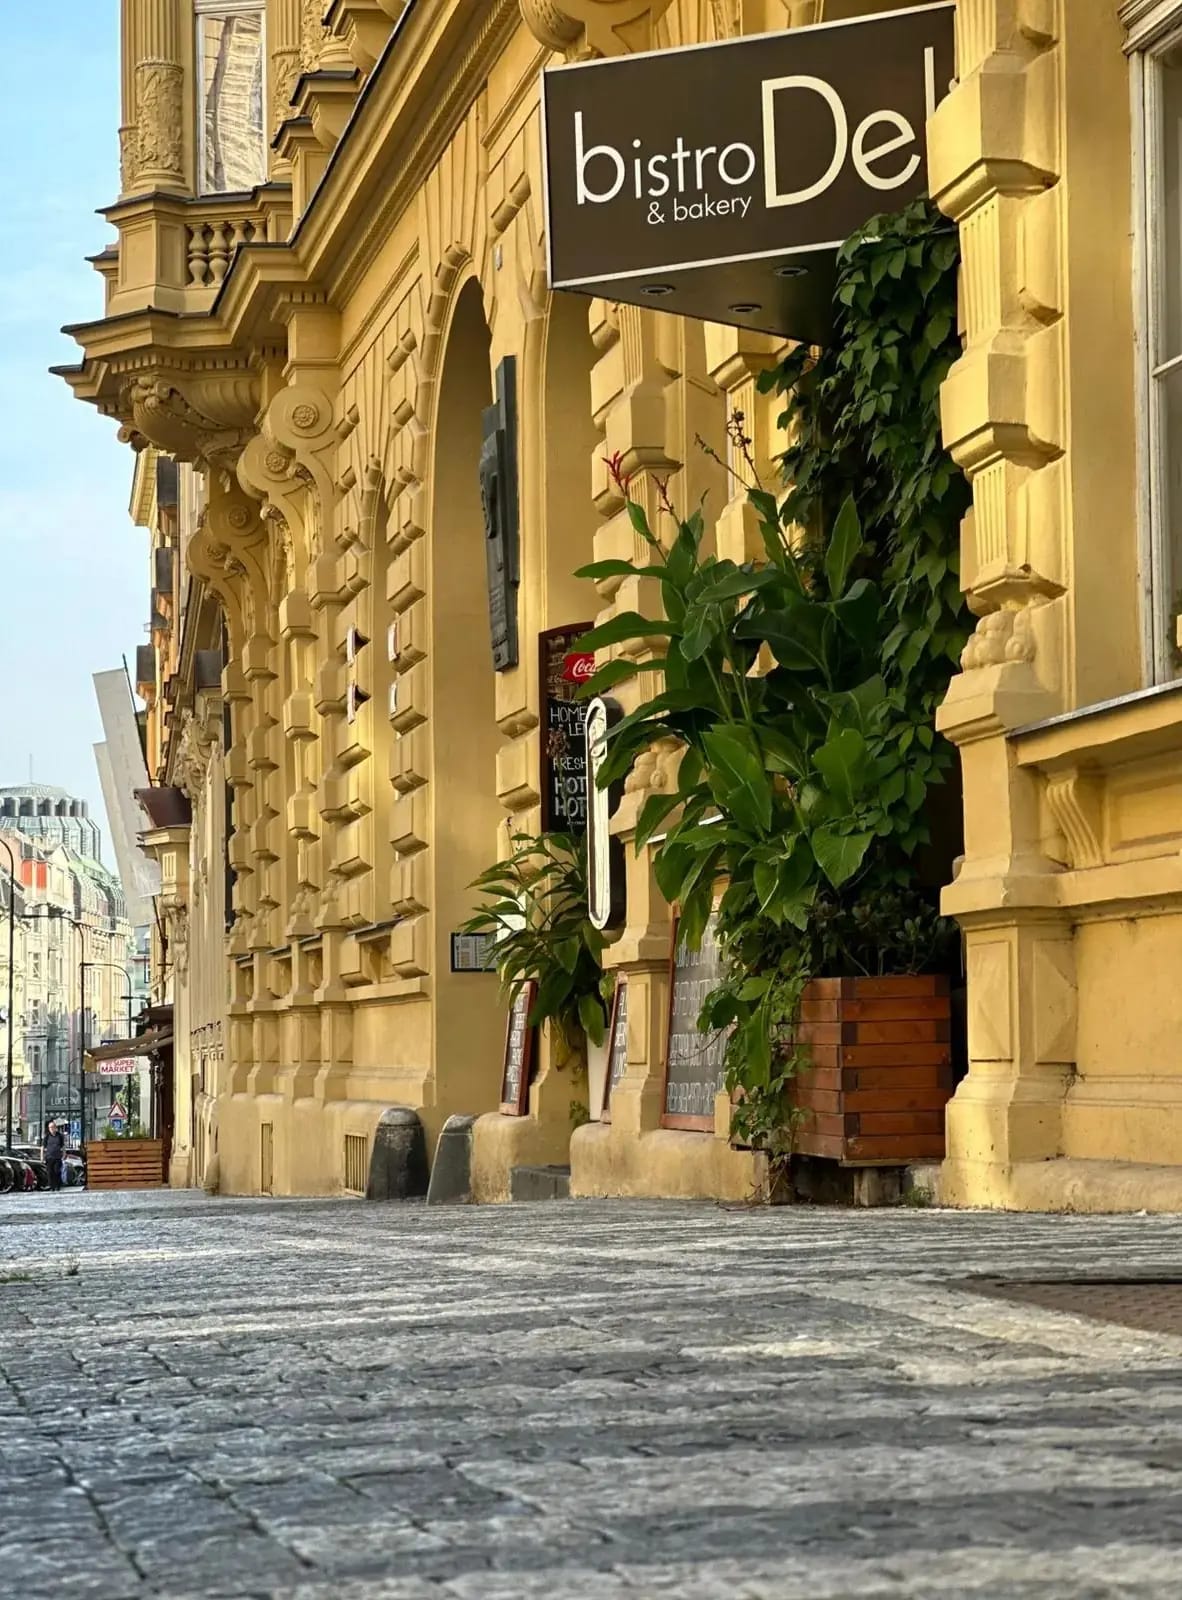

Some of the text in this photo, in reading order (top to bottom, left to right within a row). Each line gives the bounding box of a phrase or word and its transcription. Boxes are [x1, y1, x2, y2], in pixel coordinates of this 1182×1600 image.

[574, 111, 756, 205] bistro
[647, 195, 752, 225] & bakery
[568, 722, 586, 736] LE
[554, 776, 587, 795] HOT
